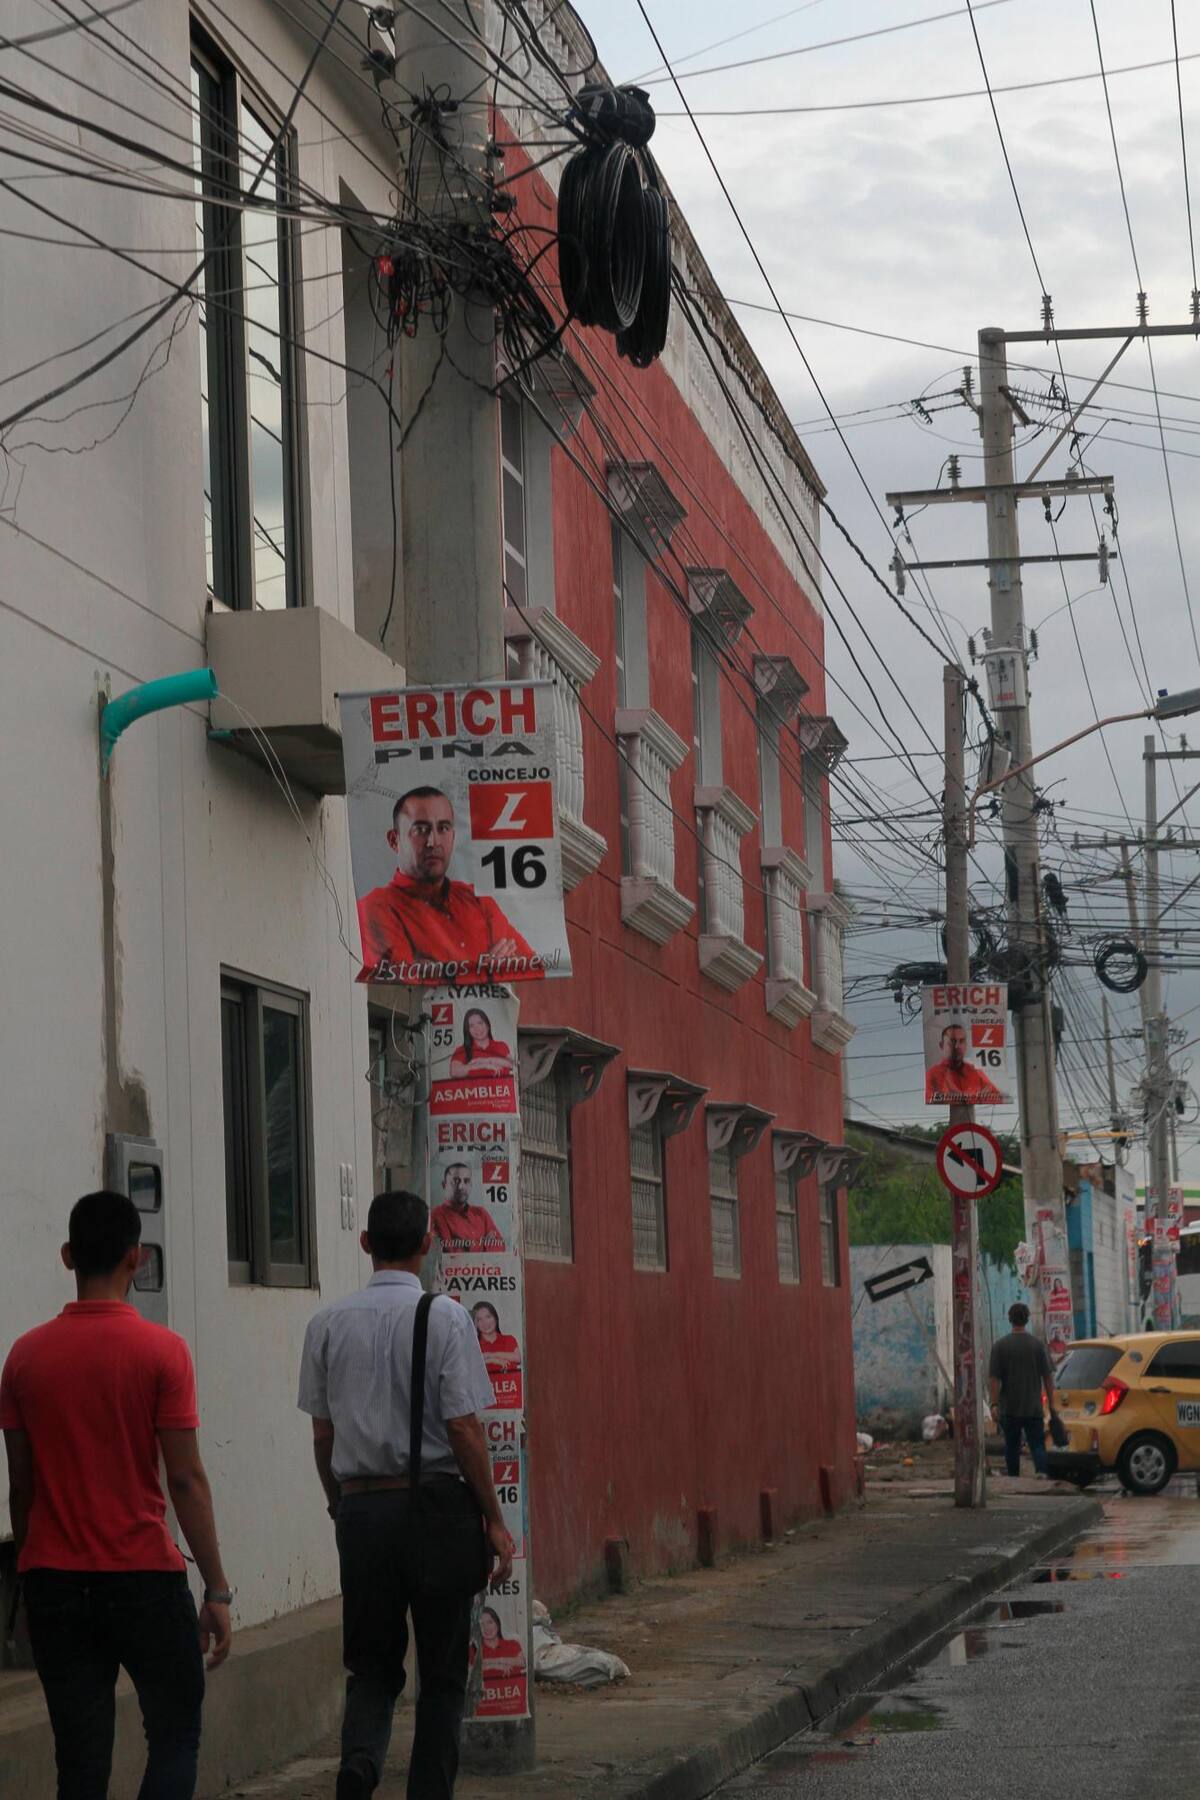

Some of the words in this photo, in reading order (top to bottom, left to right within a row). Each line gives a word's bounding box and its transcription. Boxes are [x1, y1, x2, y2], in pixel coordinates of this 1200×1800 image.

[369, 687, 537, 743] ERICH
[374, 739, 536, 765] PIÑA
[467, 766, 551, 782] CONCEJO
[489, 792, 528, 832] L
[481, 844, 548, 889] 16
[932, 986, 1000, 1008] ERICH
[433, 1028, 454, 1047] 55
[975, 1049, 1002, 1067] 16
[434, 1085, 511, 1104] ASAMBLEA
[437, 1122, 507, 1144] ERICH
[485, 1185, 508, 1203] 16
[497, 1486, 518, 1504] 16
